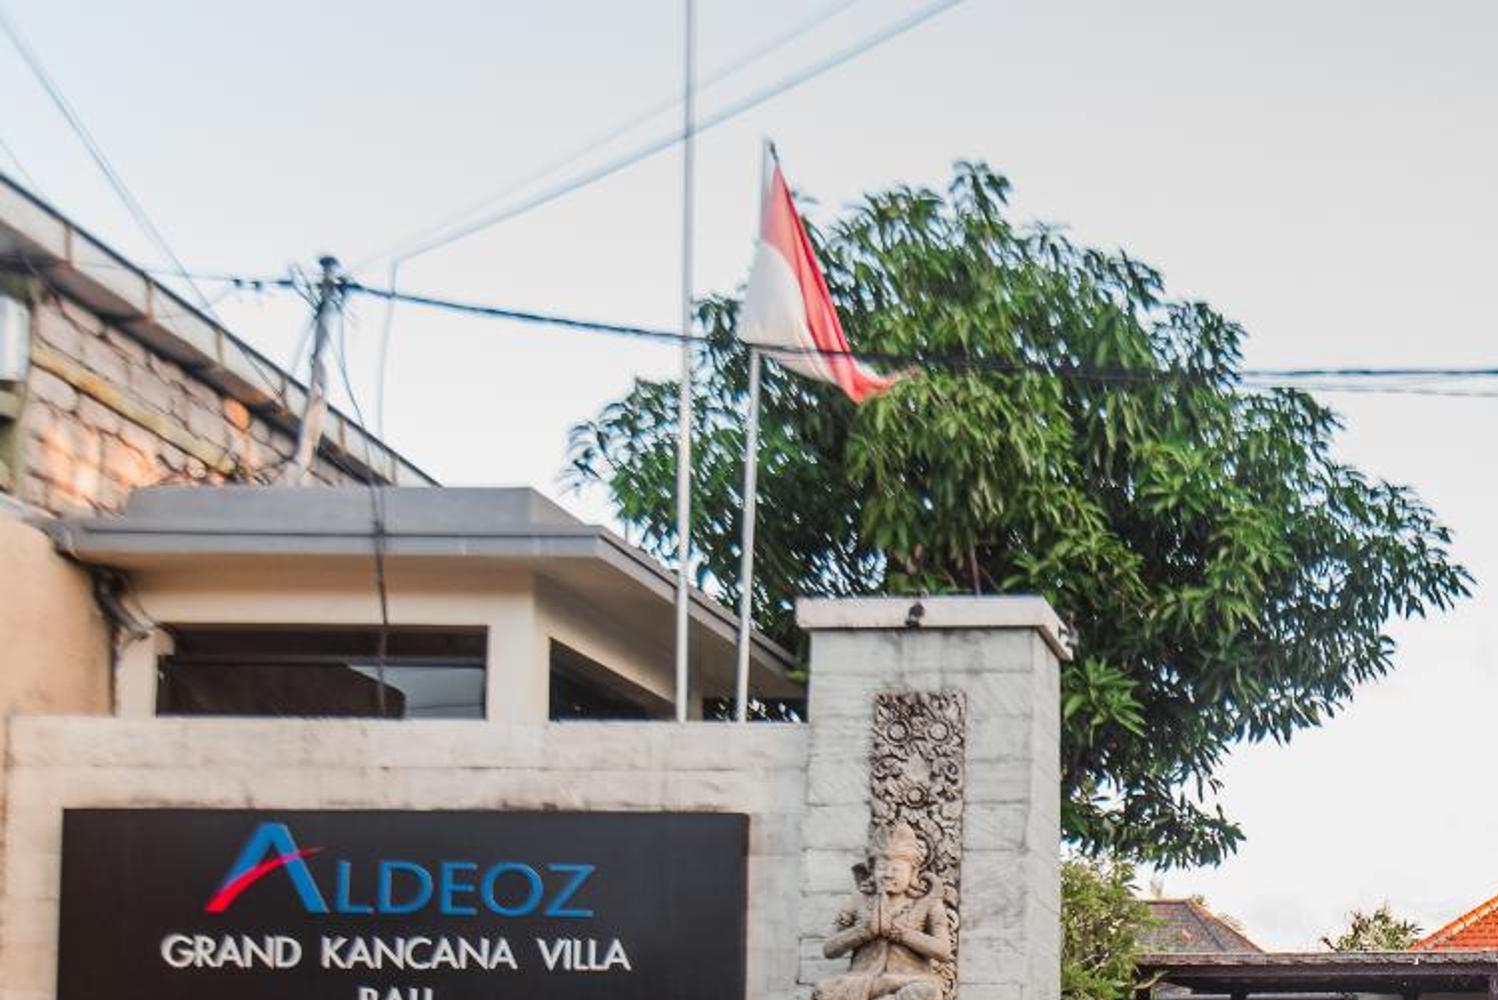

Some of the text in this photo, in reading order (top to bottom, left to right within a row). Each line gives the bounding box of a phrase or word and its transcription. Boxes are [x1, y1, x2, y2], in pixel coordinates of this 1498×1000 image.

[206, 821, 597, 918] ALDEOZ
[160, 933, 632, 972] GRAND KANCANA VILLA
